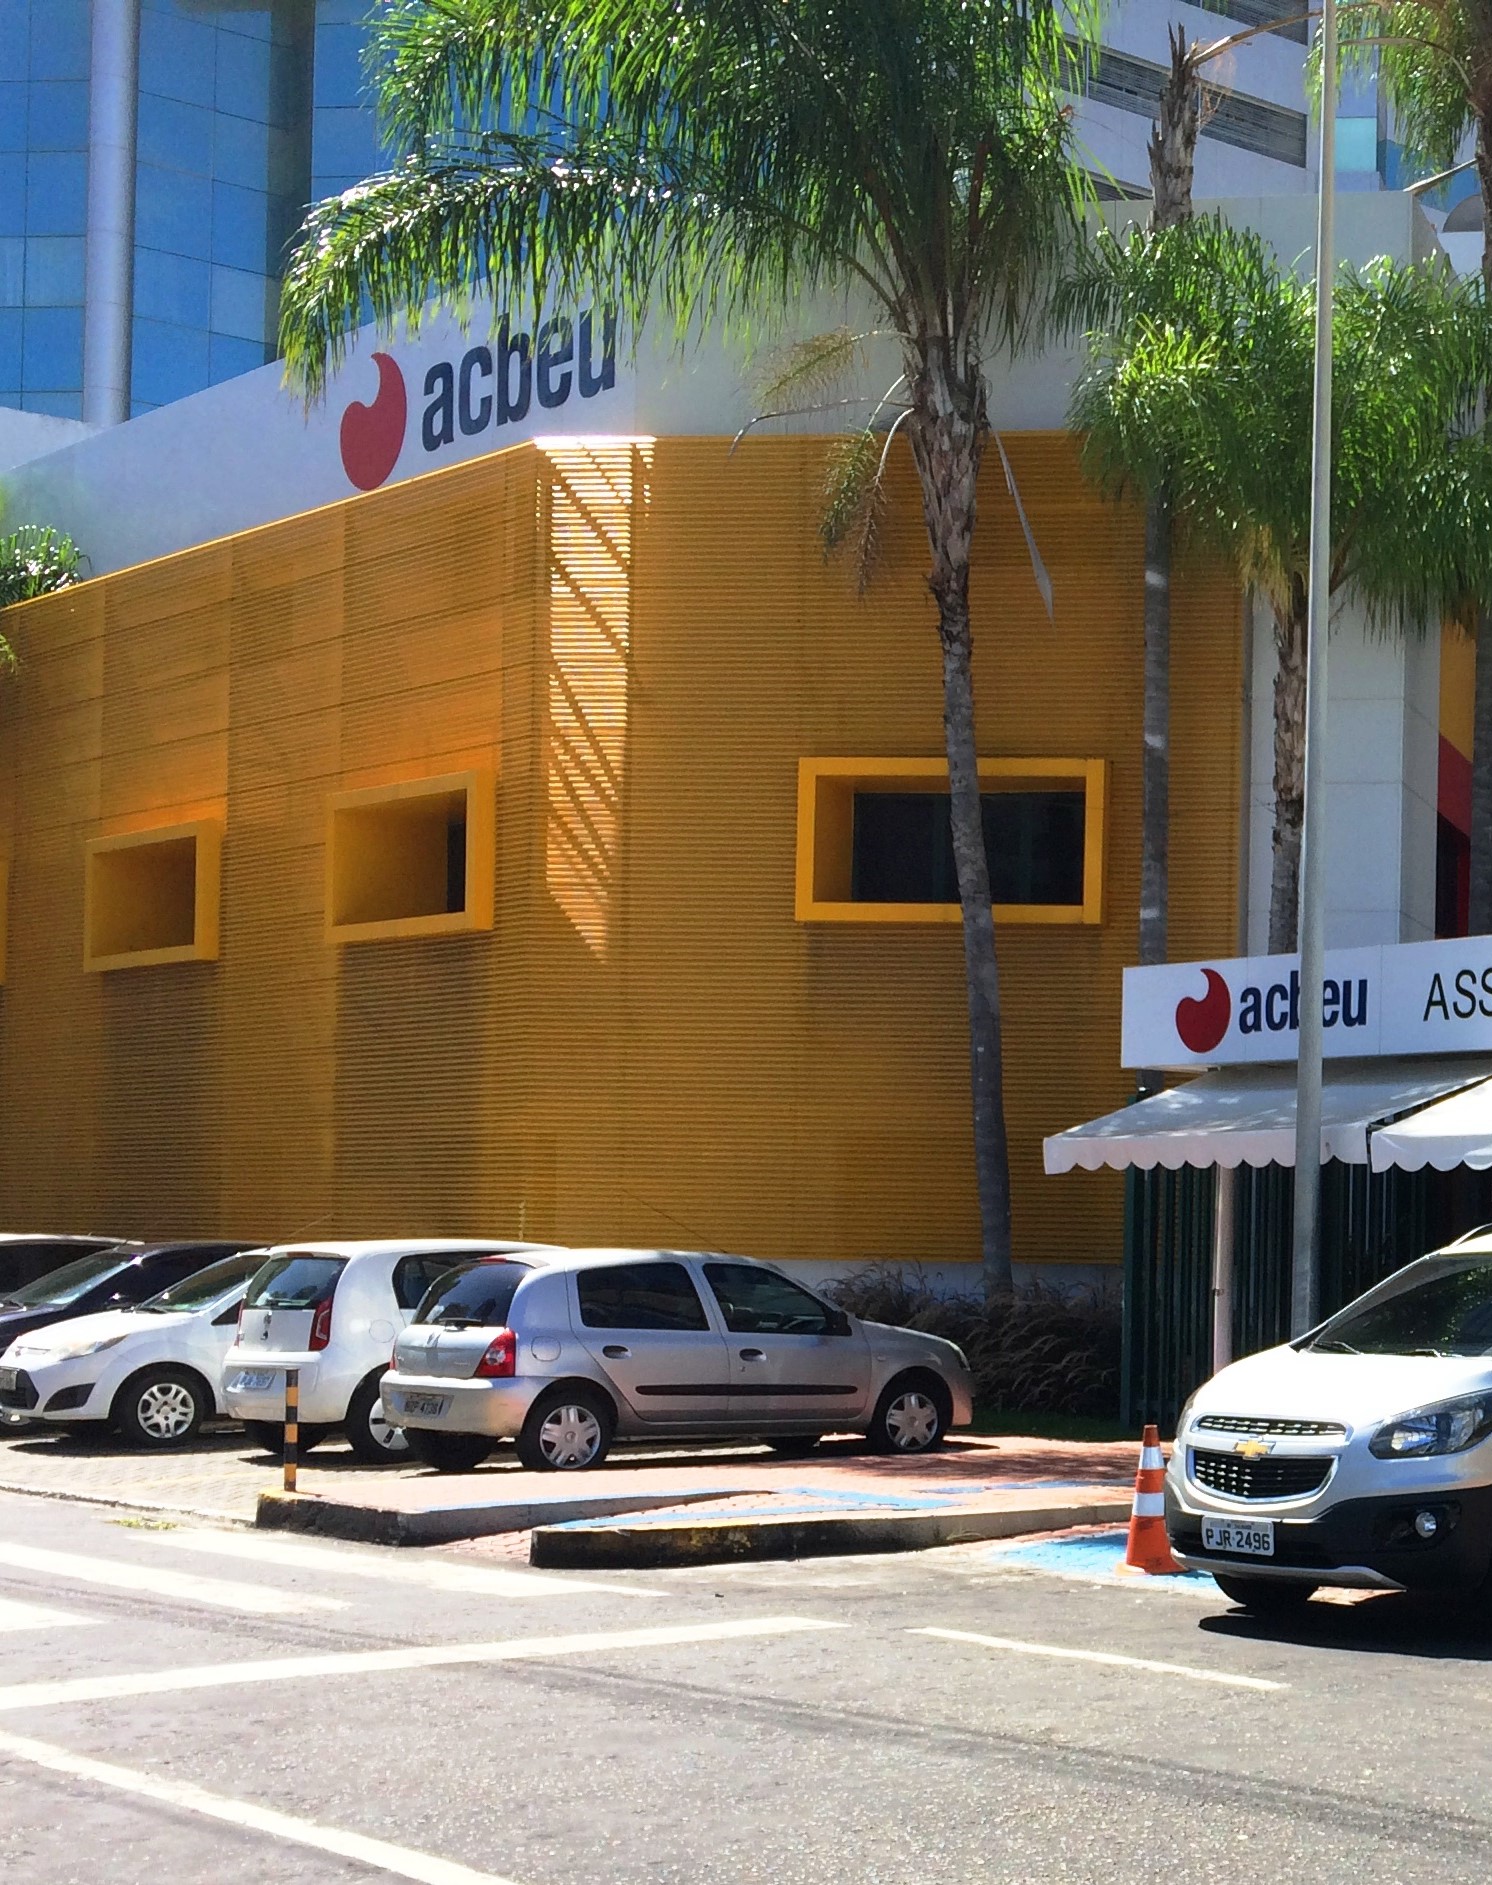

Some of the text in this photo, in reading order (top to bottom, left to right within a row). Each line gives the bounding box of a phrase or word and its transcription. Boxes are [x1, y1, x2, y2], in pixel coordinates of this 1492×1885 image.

[422, 302, 618, 452] acbeu
[1206, 1528, 1271, 1551] PJR 2496
